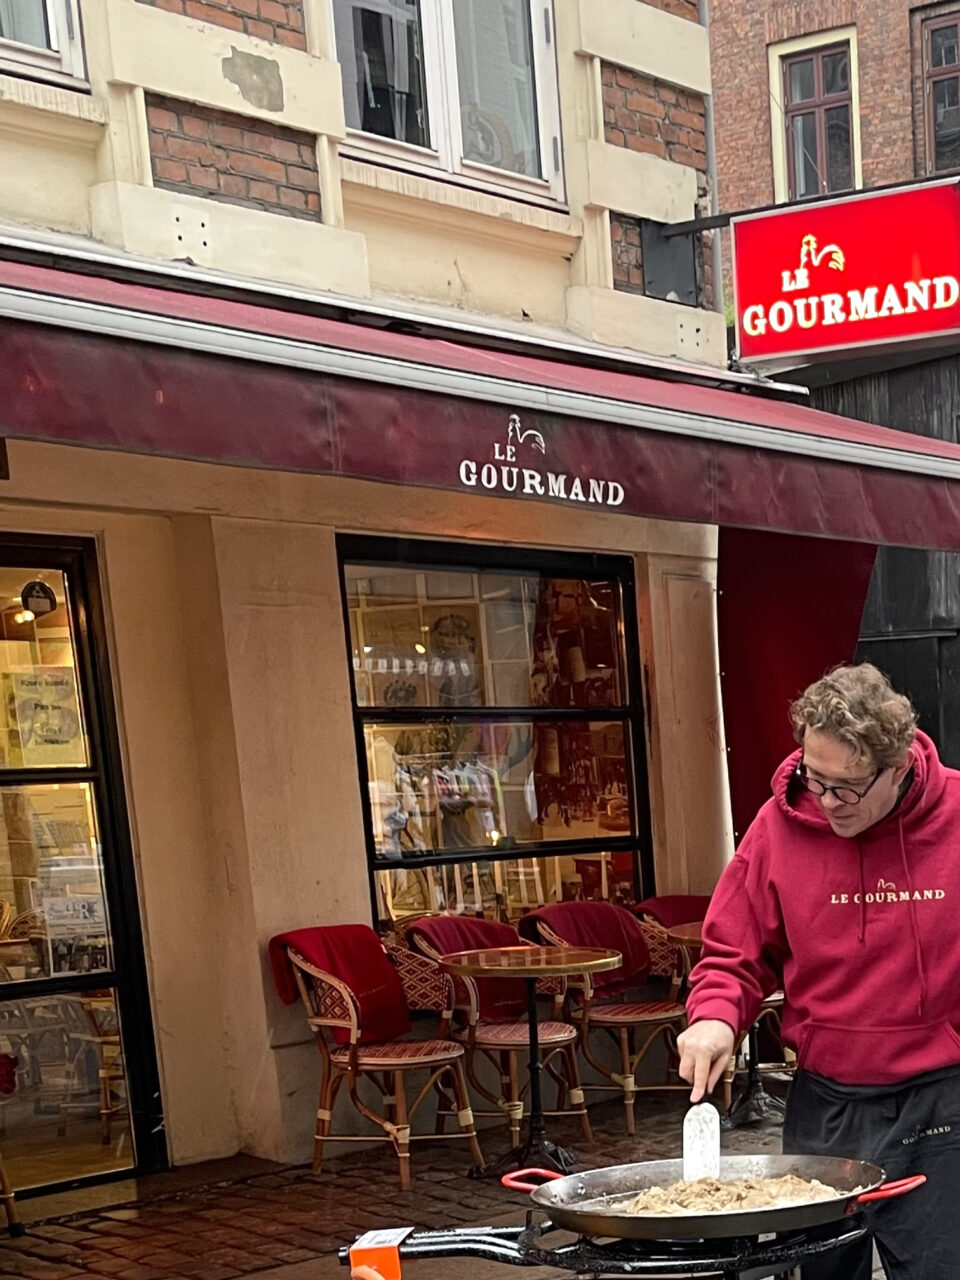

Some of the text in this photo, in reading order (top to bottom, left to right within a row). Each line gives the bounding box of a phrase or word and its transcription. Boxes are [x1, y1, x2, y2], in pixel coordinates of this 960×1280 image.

[781, 267, 810, 293] LE
[742, 275, 960, 336] GOURMAND
[493, 442, 517, 462] LE
[459, 459, 625, 506] GOURMAND
[830, 893, 849, 904] LE
